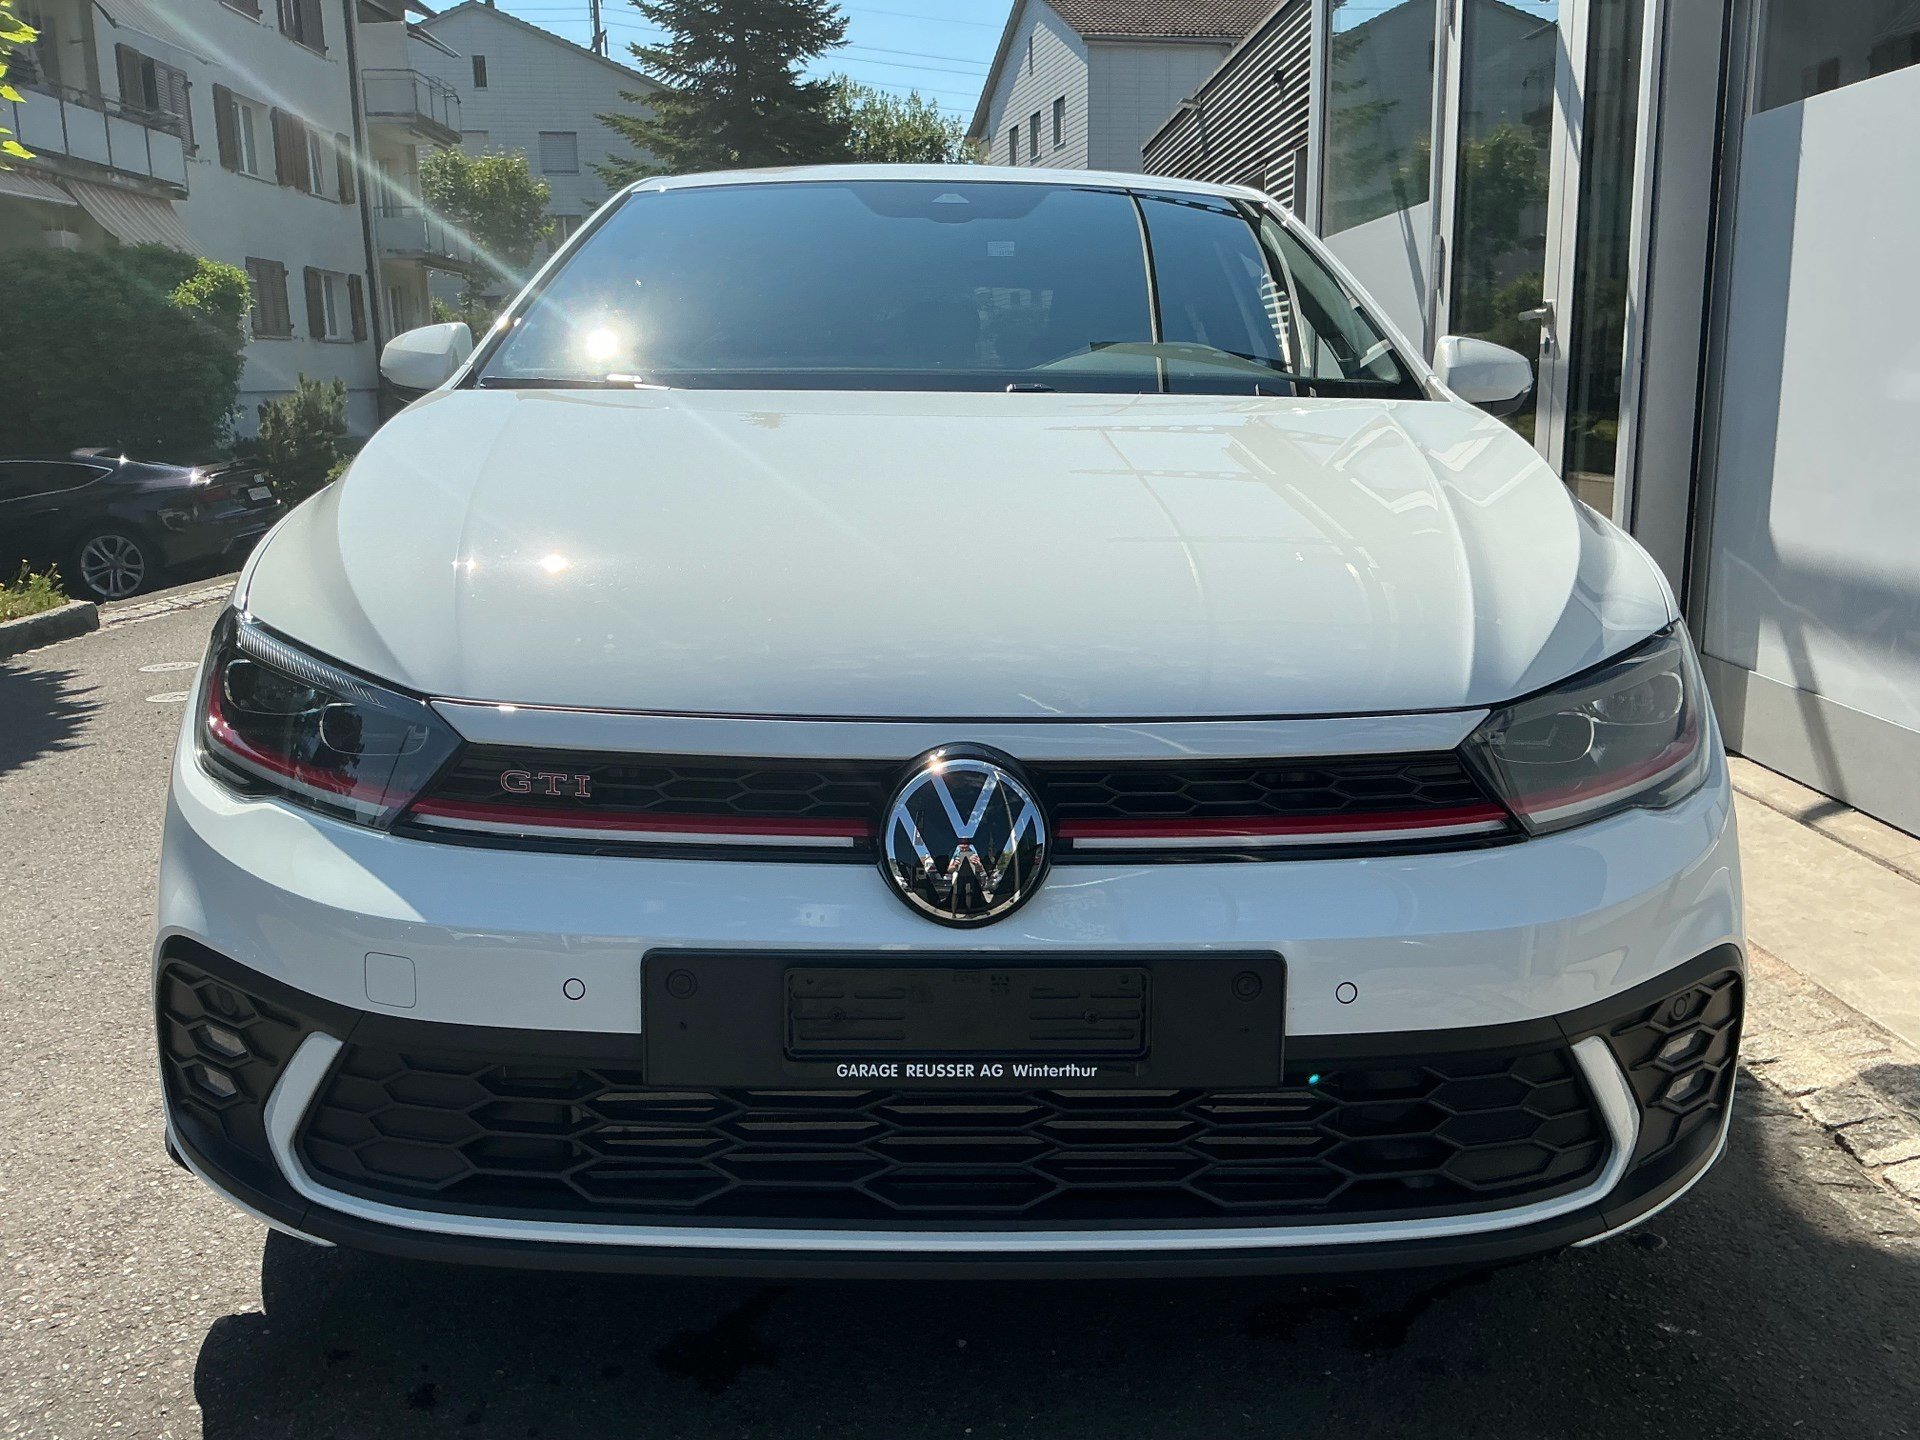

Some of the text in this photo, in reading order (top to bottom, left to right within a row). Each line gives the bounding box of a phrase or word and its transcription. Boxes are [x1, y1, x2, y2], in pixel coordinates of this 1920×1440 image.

[500, 769, 591, 798] GTI
[885, 758, 1046, 921] VW
[836, 1063, 1098, 1078] GARAGE REUSSER AG Winterthur
